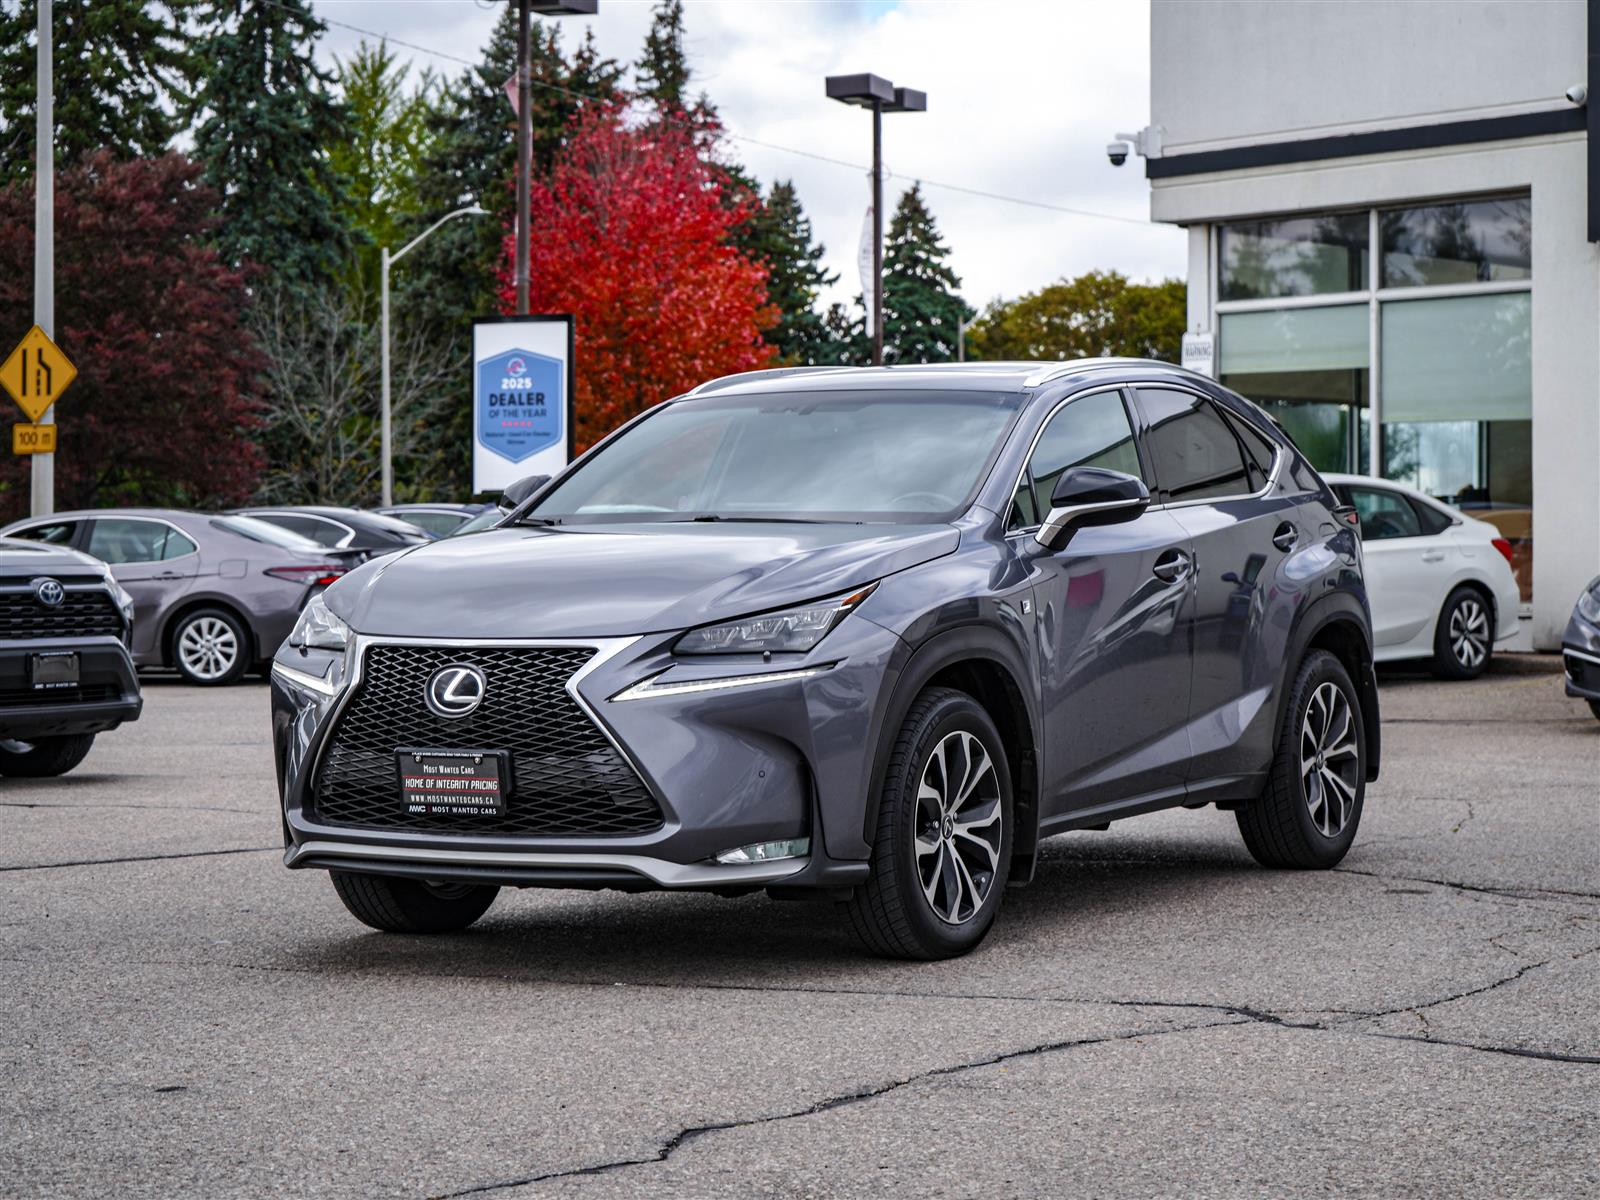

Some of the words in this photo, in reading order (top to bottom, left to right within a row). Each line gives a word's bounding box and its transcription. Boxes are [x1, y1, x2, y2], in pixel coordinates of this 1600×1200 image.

[501, 377, 533, 390] 2025
[489, 392, 545, 407] DEALER
[489, 409, 500, 418] OF
[503, 408, 519, 418] THE
[522, 407, 547, 418] YEAR
[19, 432, 38, 445] 100
[42, 433, 51, 444] m
[405, 778, 424, 788] HOME
[425, 779, 435, 789] OF
[436, 780, 470, 790] INTEGRITY
[470, 780, 498, 791] PRICING
[432, 806, 449, 814] MOST
[452, 806, 478, 815] WANTED
[480, 807, 497, 815] CARS
